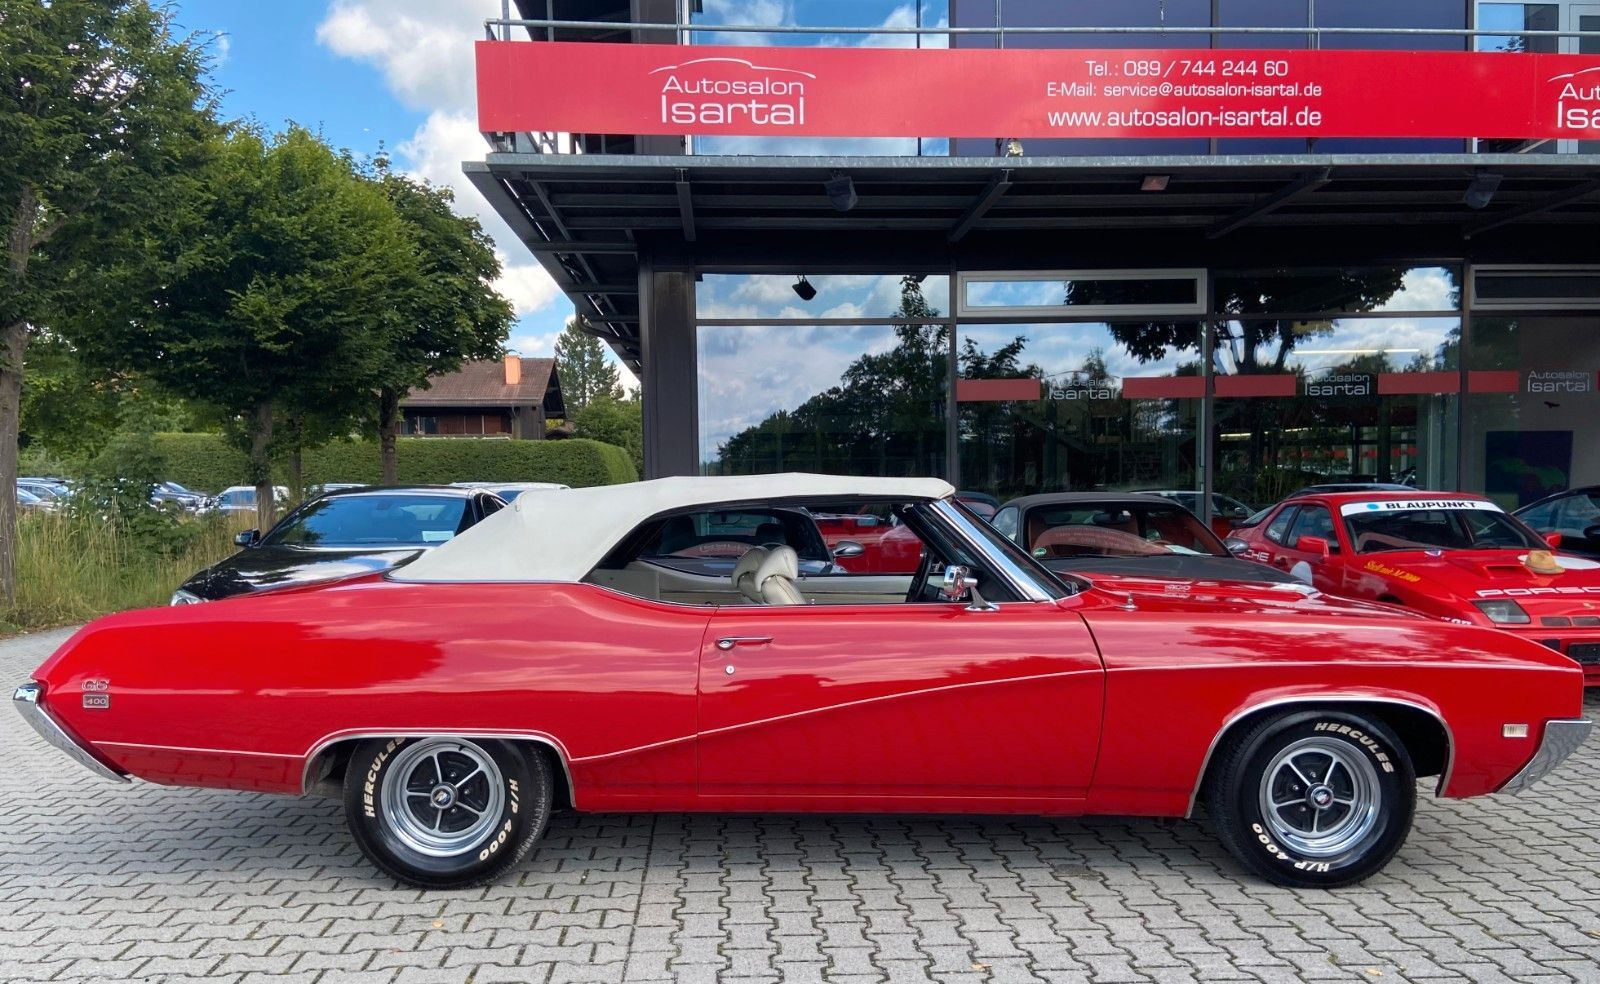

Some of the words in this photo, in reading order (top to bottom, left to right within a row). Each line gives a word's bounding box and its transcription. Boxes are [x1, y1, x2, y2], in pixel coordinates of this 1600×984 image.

[1085, 60, 1119, 77] Tel.:
[1123, 60, 1161, 77] 089
[1163, 60, 1176, 78] /
[1180, 60, 1215, 77] 744
[1222, 60, 1257, 77] 244
[1264, 60, 1288, 77] 60
[662, 75, 804, 95] Autosalon
[1047, 82, 1097, 97] E-Mail:
[1103, 82, 1322, 97] service@autosalon-isartal.de
[661, 94, 806, 125] Isartal
[1048, 106, 1322, 127] www.autosalon-isartal.de
[1528, 370, 1590, 379] Autosalon
[1048, 387, 1115, 400] Isartal
[1304, 382, 1370, 396] Isartal
[1528, 379, 1590, 393] Isartal
[1385, 501, 1477, 510] BLAUPUNKT
[1314, 722, 1395, 773] HERCULES
[509, 778, 520, 814] H/P
[479, 819, 513, 861] 4000
[1252, 822, 1290, 860] 4000
[1294, 861, 1330, 873] H/P
